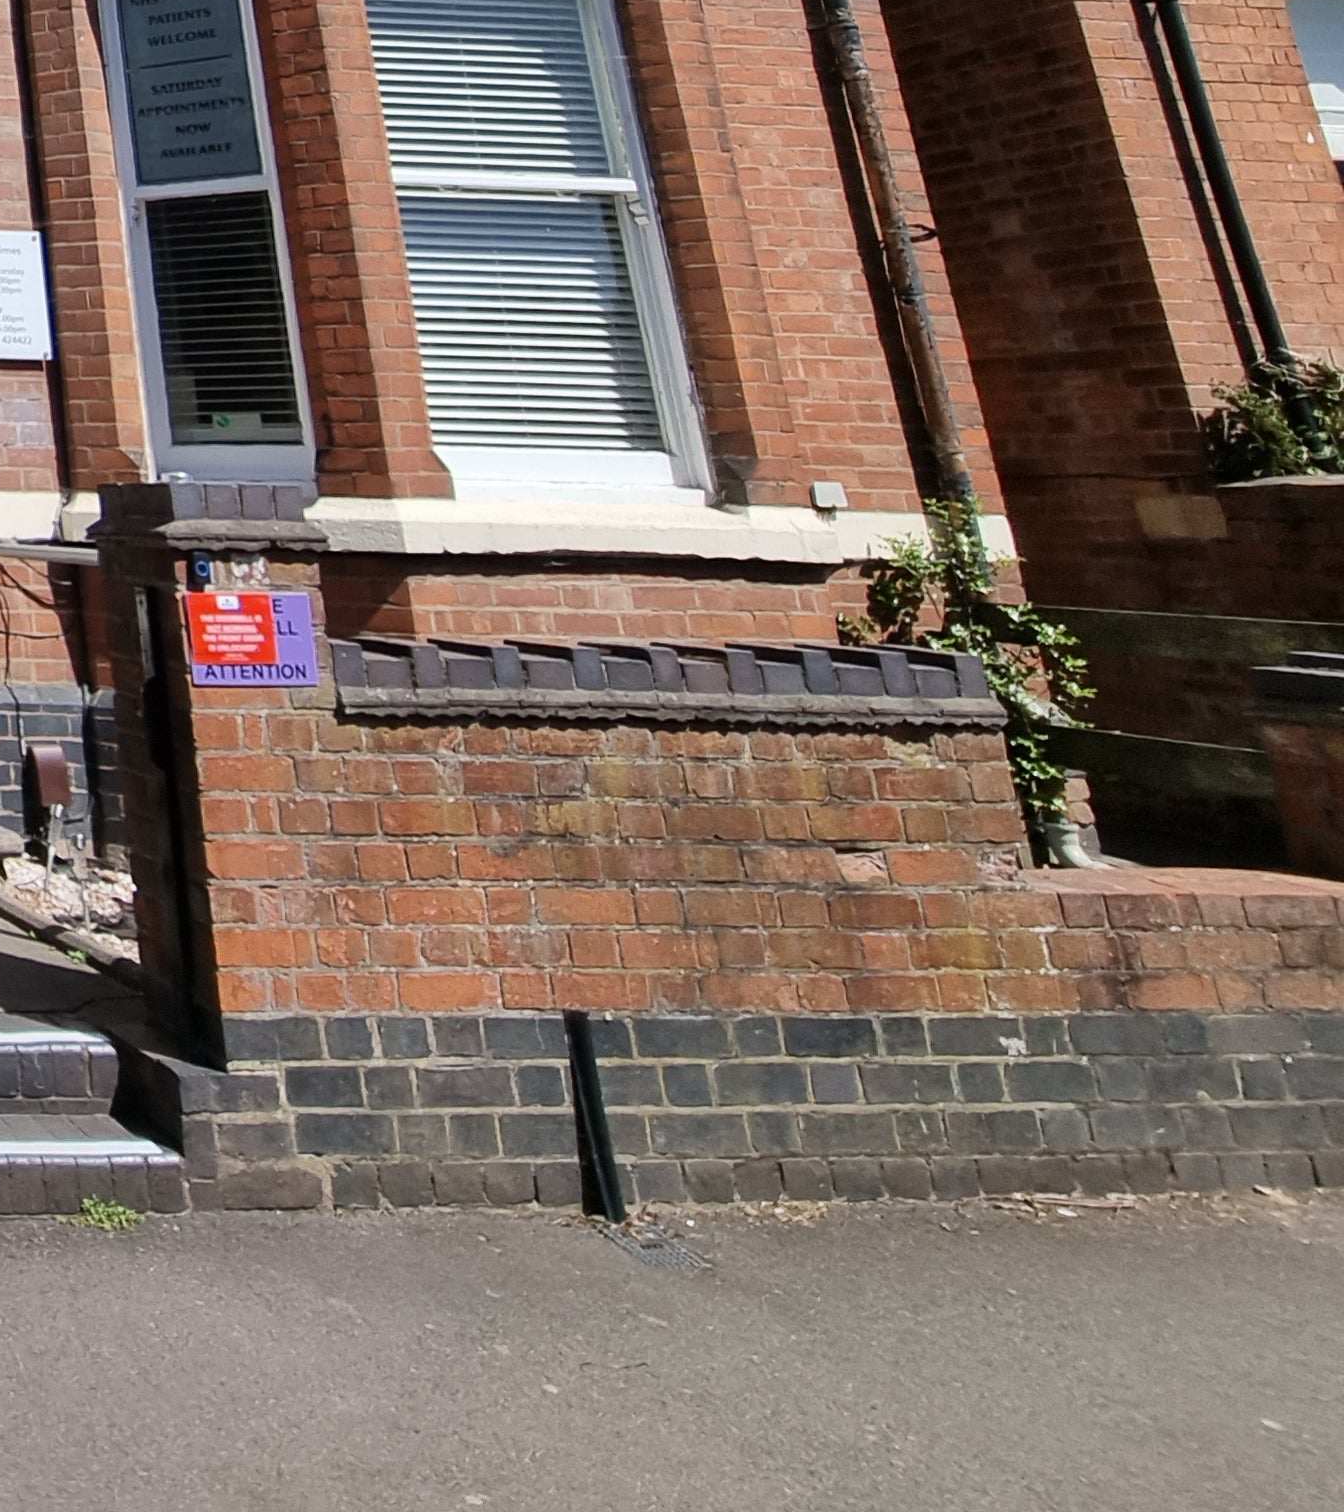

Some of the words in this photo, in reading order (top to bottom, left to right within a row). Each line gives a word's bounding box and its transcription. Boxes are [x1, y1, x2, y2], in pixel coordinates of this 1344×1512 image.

[148, 7, 211, 25] PATIENTS
[147, 28, 217, 47] WELCOME
[151, 77, 222, 95] SATURDAY
[138, 96, 245, 117] APPOINTMENTS
[175, 122, 211, 135] NOW
[160, 142, 232, 158] AVAILABLE
[205, 664, 307, 680] ATTENTION
